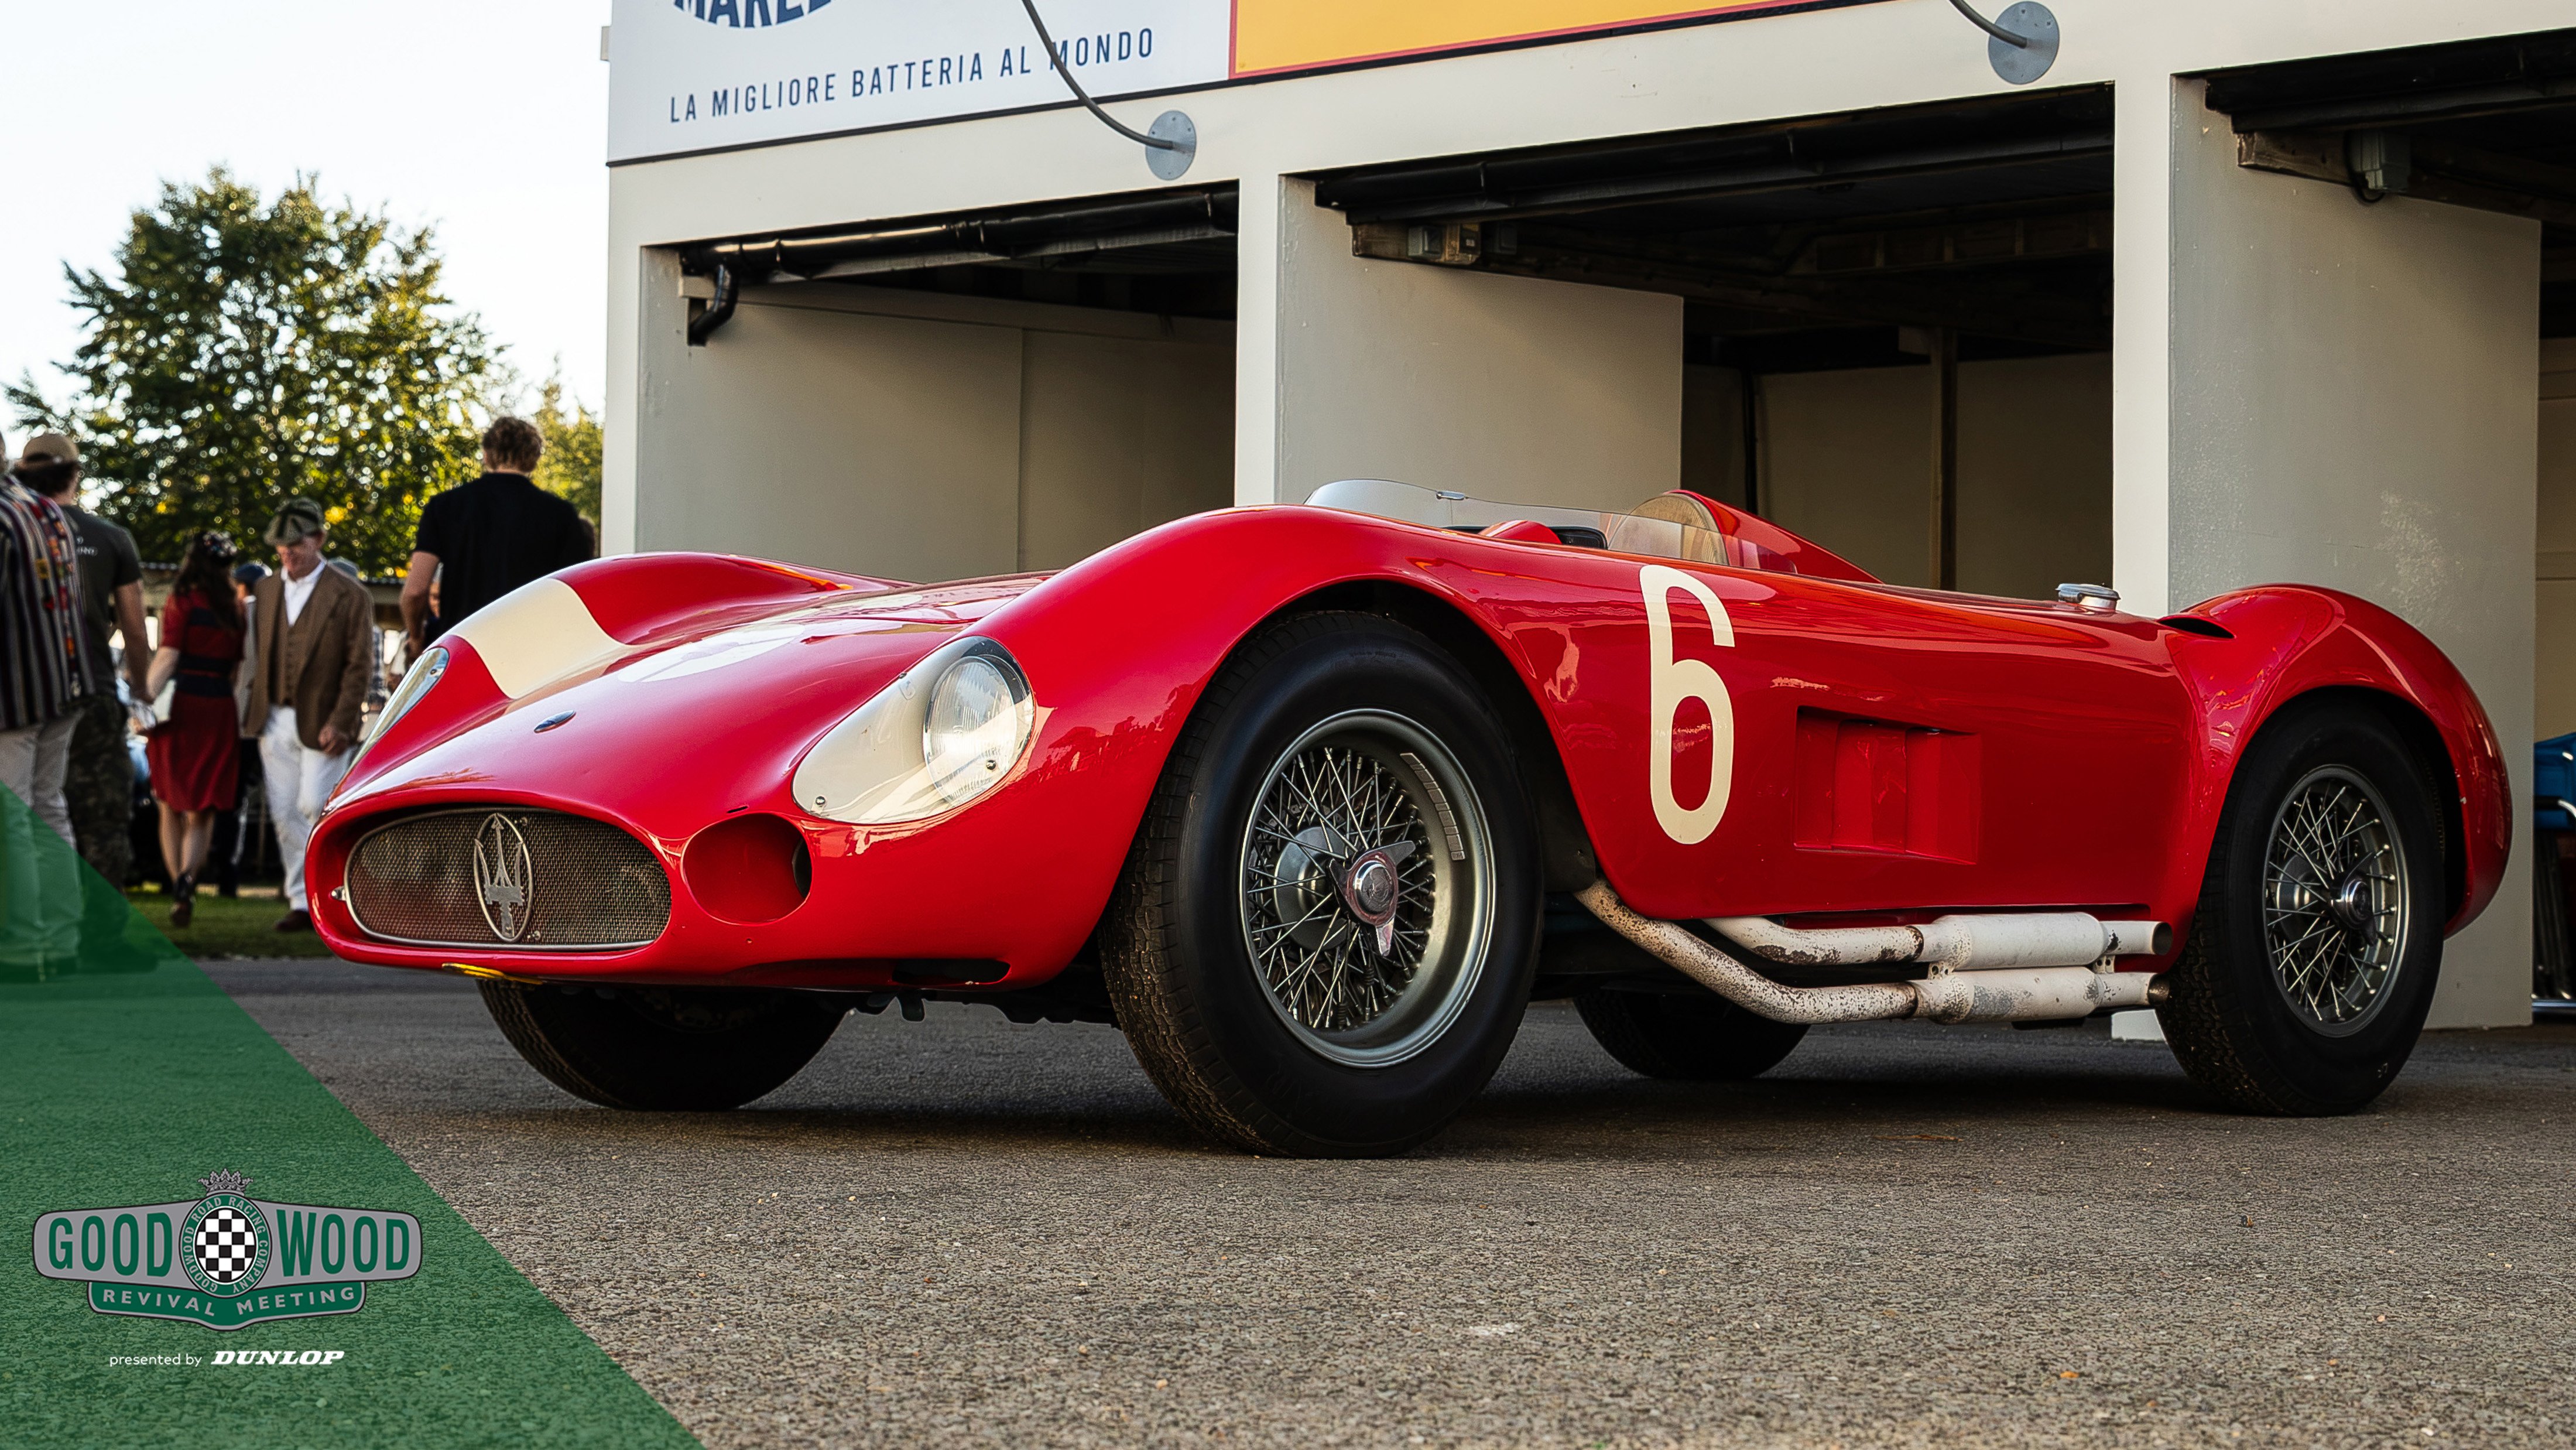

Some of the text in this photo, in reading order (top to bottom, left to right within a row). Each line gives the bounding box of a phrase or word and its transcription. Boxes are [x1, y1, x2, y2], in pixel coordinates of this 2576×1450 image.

[671, 28, 1153, 123] LA MIGLIORE BATTERIA AL MONDO
[1640, 565, 1735, 844] 6
